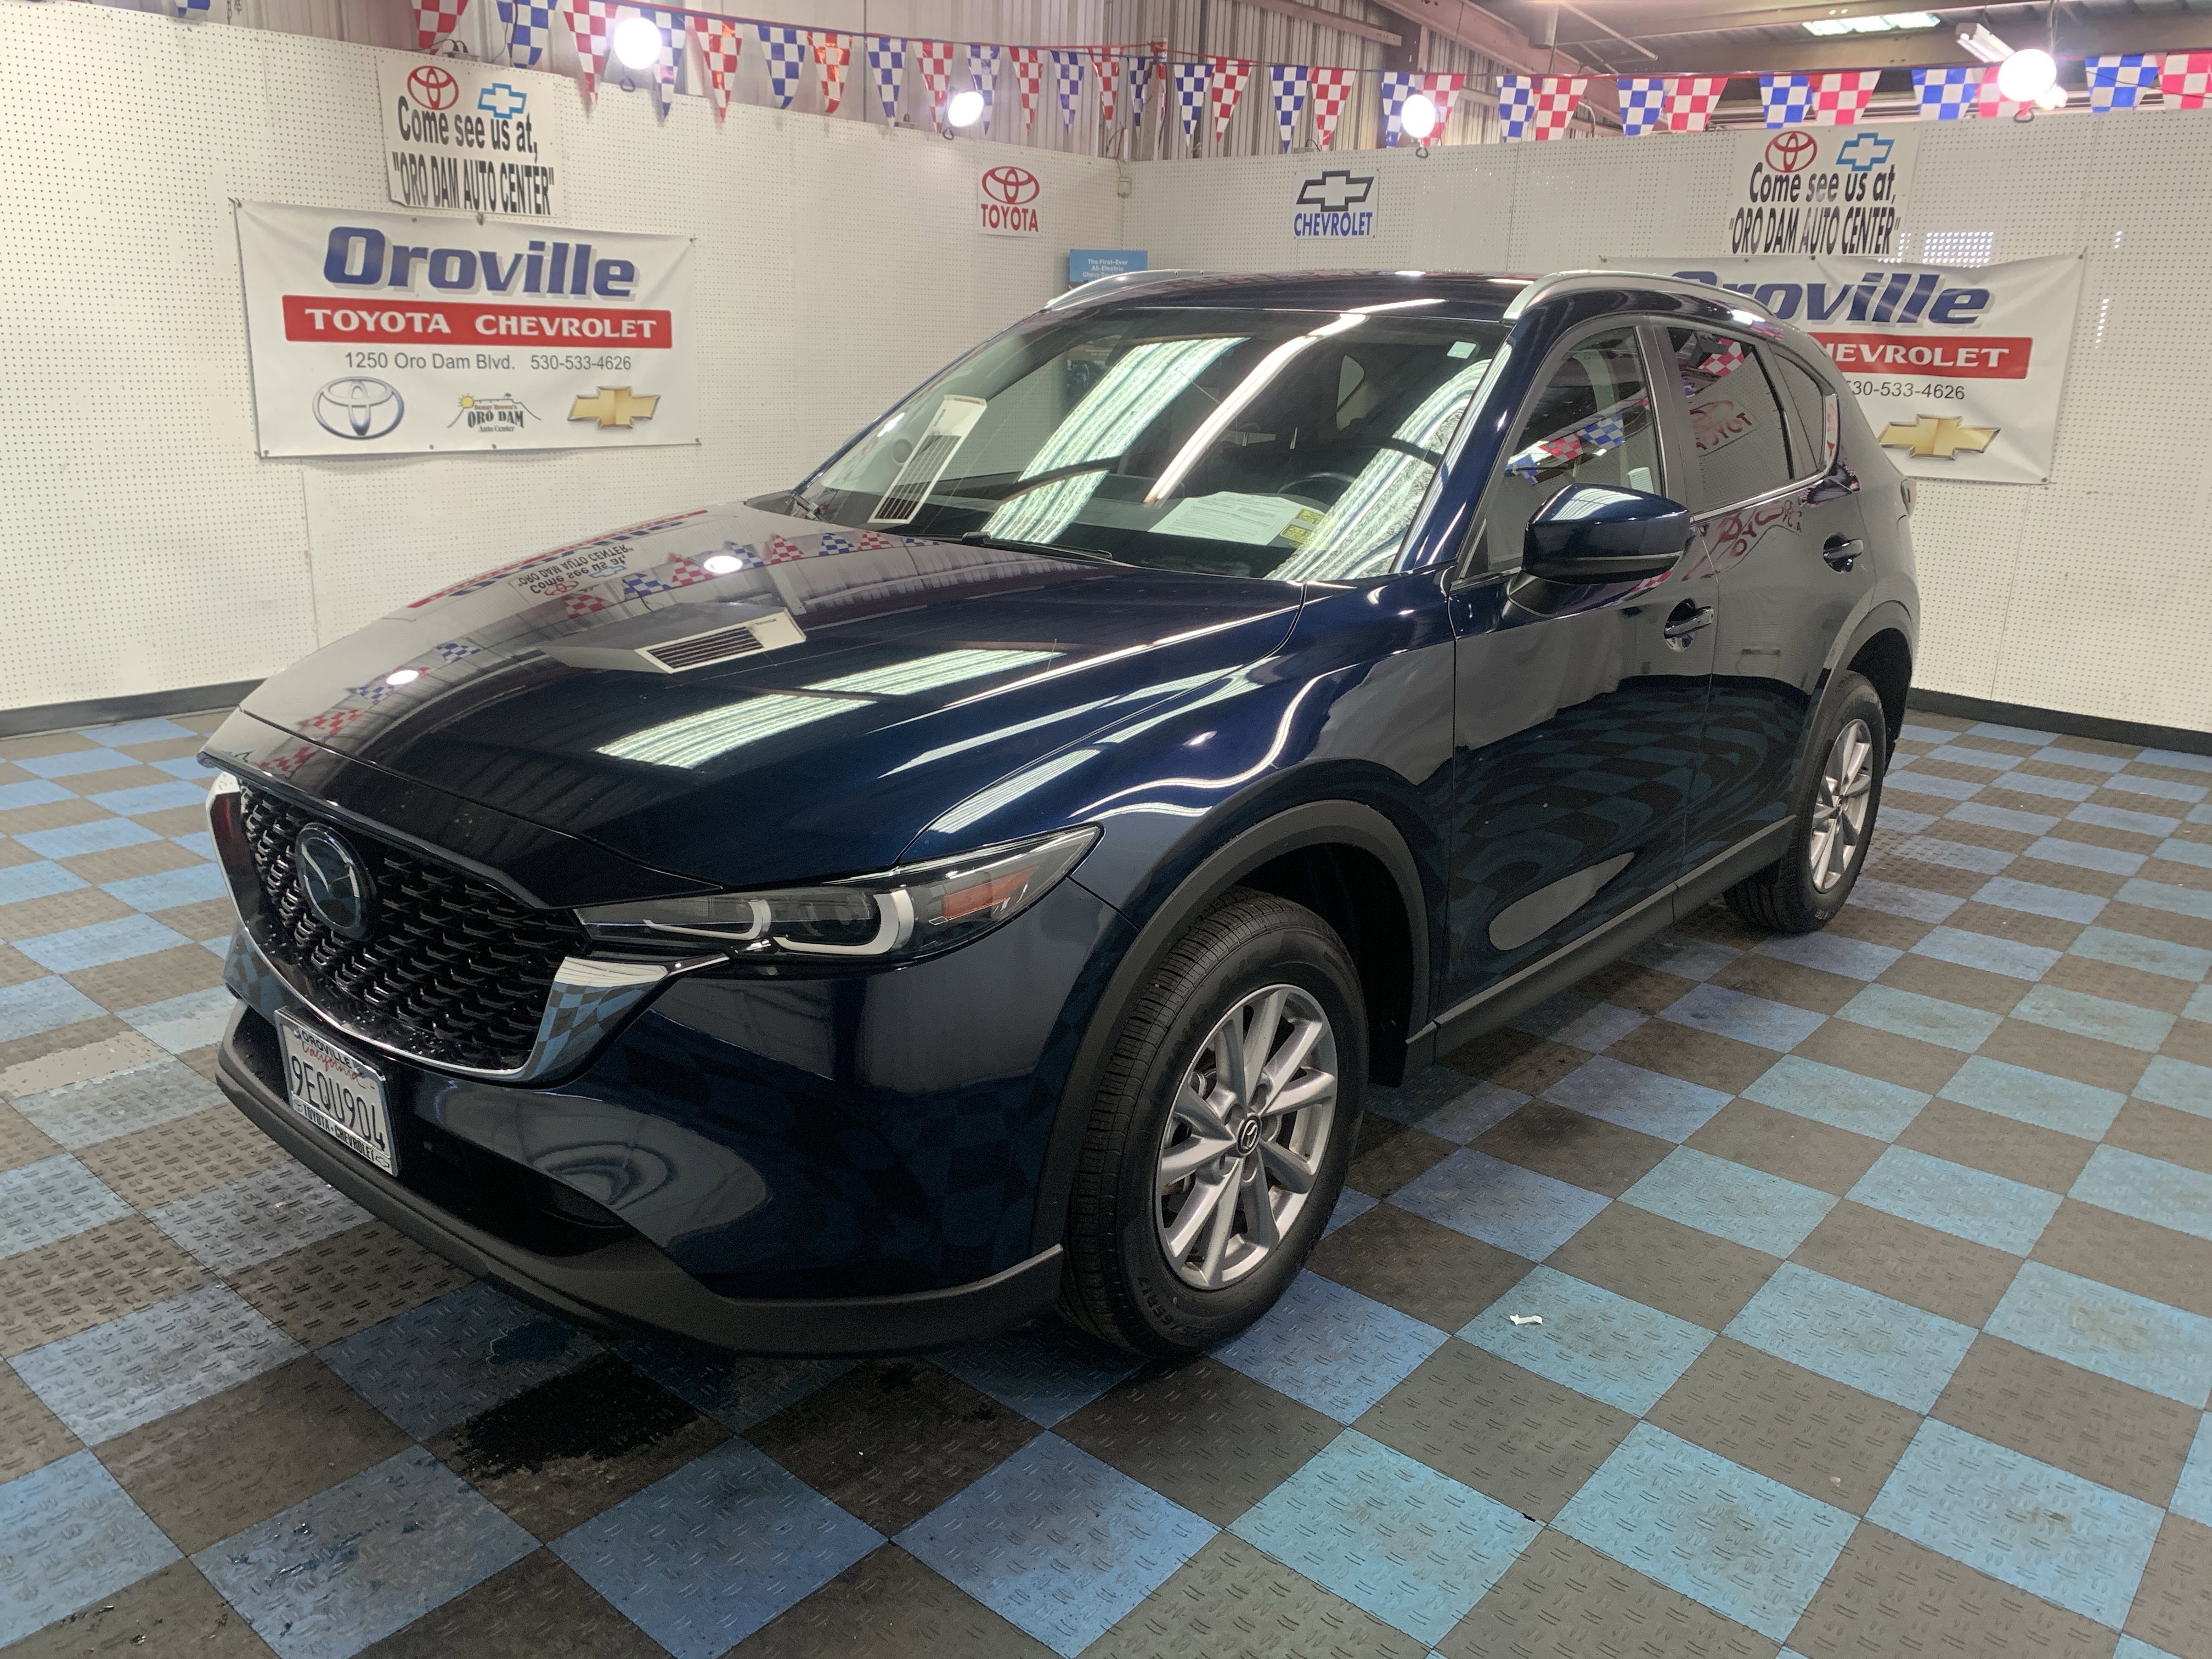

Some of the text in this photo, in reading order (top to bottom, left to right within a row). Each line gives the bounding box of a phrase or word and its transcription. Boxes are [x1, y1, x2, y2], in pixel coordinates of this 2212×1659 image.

[398, 95, 538, 163] Come see us at,
[392, 151, 555, 216] "ORO DAM AUTO CENTER"
[1750, 161, 1897, 204] Come see us at,
[980, 204, 1039, 232] TOYOTA
[1294, 211, 1373, 237] CHEVROLET
[1729, 206, 1901, 255] "ORO DAM AUTO CENTER"
[323, 226, 637, 298] Oroville
[304, 308, 657, 338] TOYOTA CHEVROLET
[345, 352, 631, 371] 1250 Oro Dam Blvd. 530-533-4626
[1826, 343, 2010, 367] HEVROLET
[1847, 380, 1965, 399] 30-533-4626
[468, 410, 524, 428] ORO DAM
[302, 1030, 353, 1070] OROVILLE
[291, 1055, 385, 1152] 9EQU904
[302, 1103, 374, 1161] TOYOTA CHEVROLET
